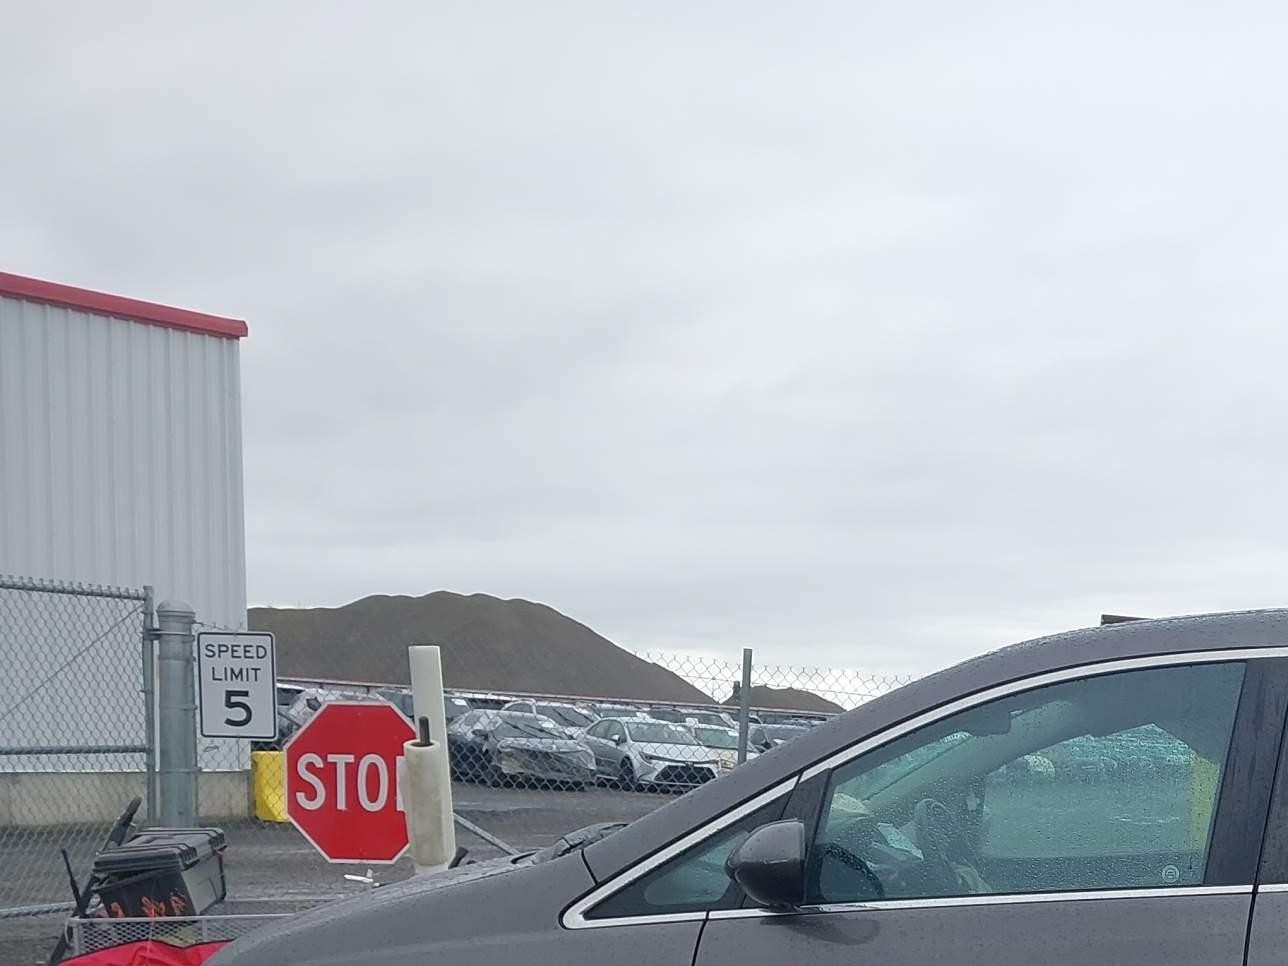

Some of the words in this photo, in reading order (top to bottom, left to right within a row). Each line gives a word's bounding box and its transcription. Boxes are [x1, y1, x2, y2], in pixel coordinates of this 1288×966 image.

[204, 643, 268, 660] SPEED
[211, 667, 262, 682] LIMIT
[224, 690, 253, 727] 5
